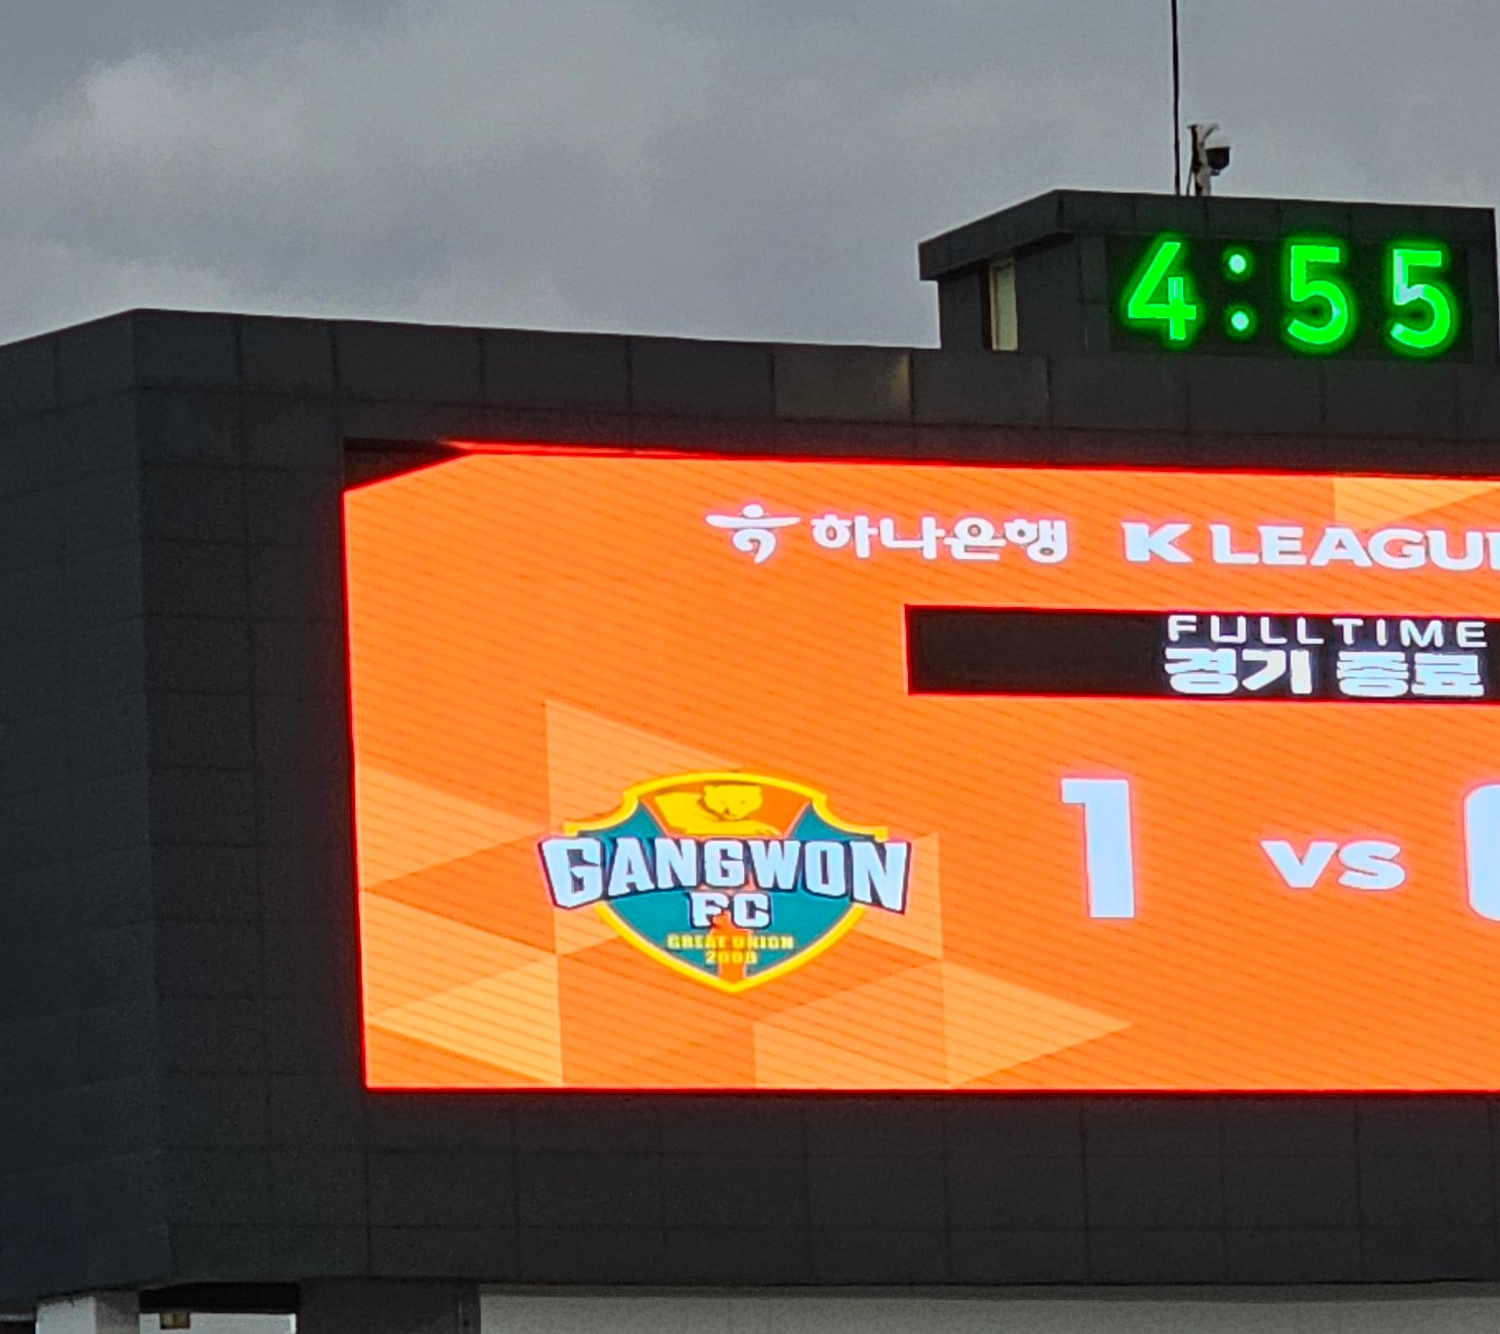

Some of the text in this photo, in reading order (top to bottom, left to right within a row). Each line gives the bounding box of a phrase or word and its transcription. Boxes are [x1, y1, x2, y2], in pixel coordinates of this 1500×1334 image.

[1127, 241, 1451, 348] 4:55
[811, 514, 1068, 563] 하나은행
[1121, 522, 1193, 563] K
[1167, 615, 1488, 648] FULL TIME
[1164, 647, 1486, 697] 경기 종료
[1061, 778, 1134, 919] 1
[541, 837, 910, 913] GANGWON
[688, 892, 772, 929] FC
